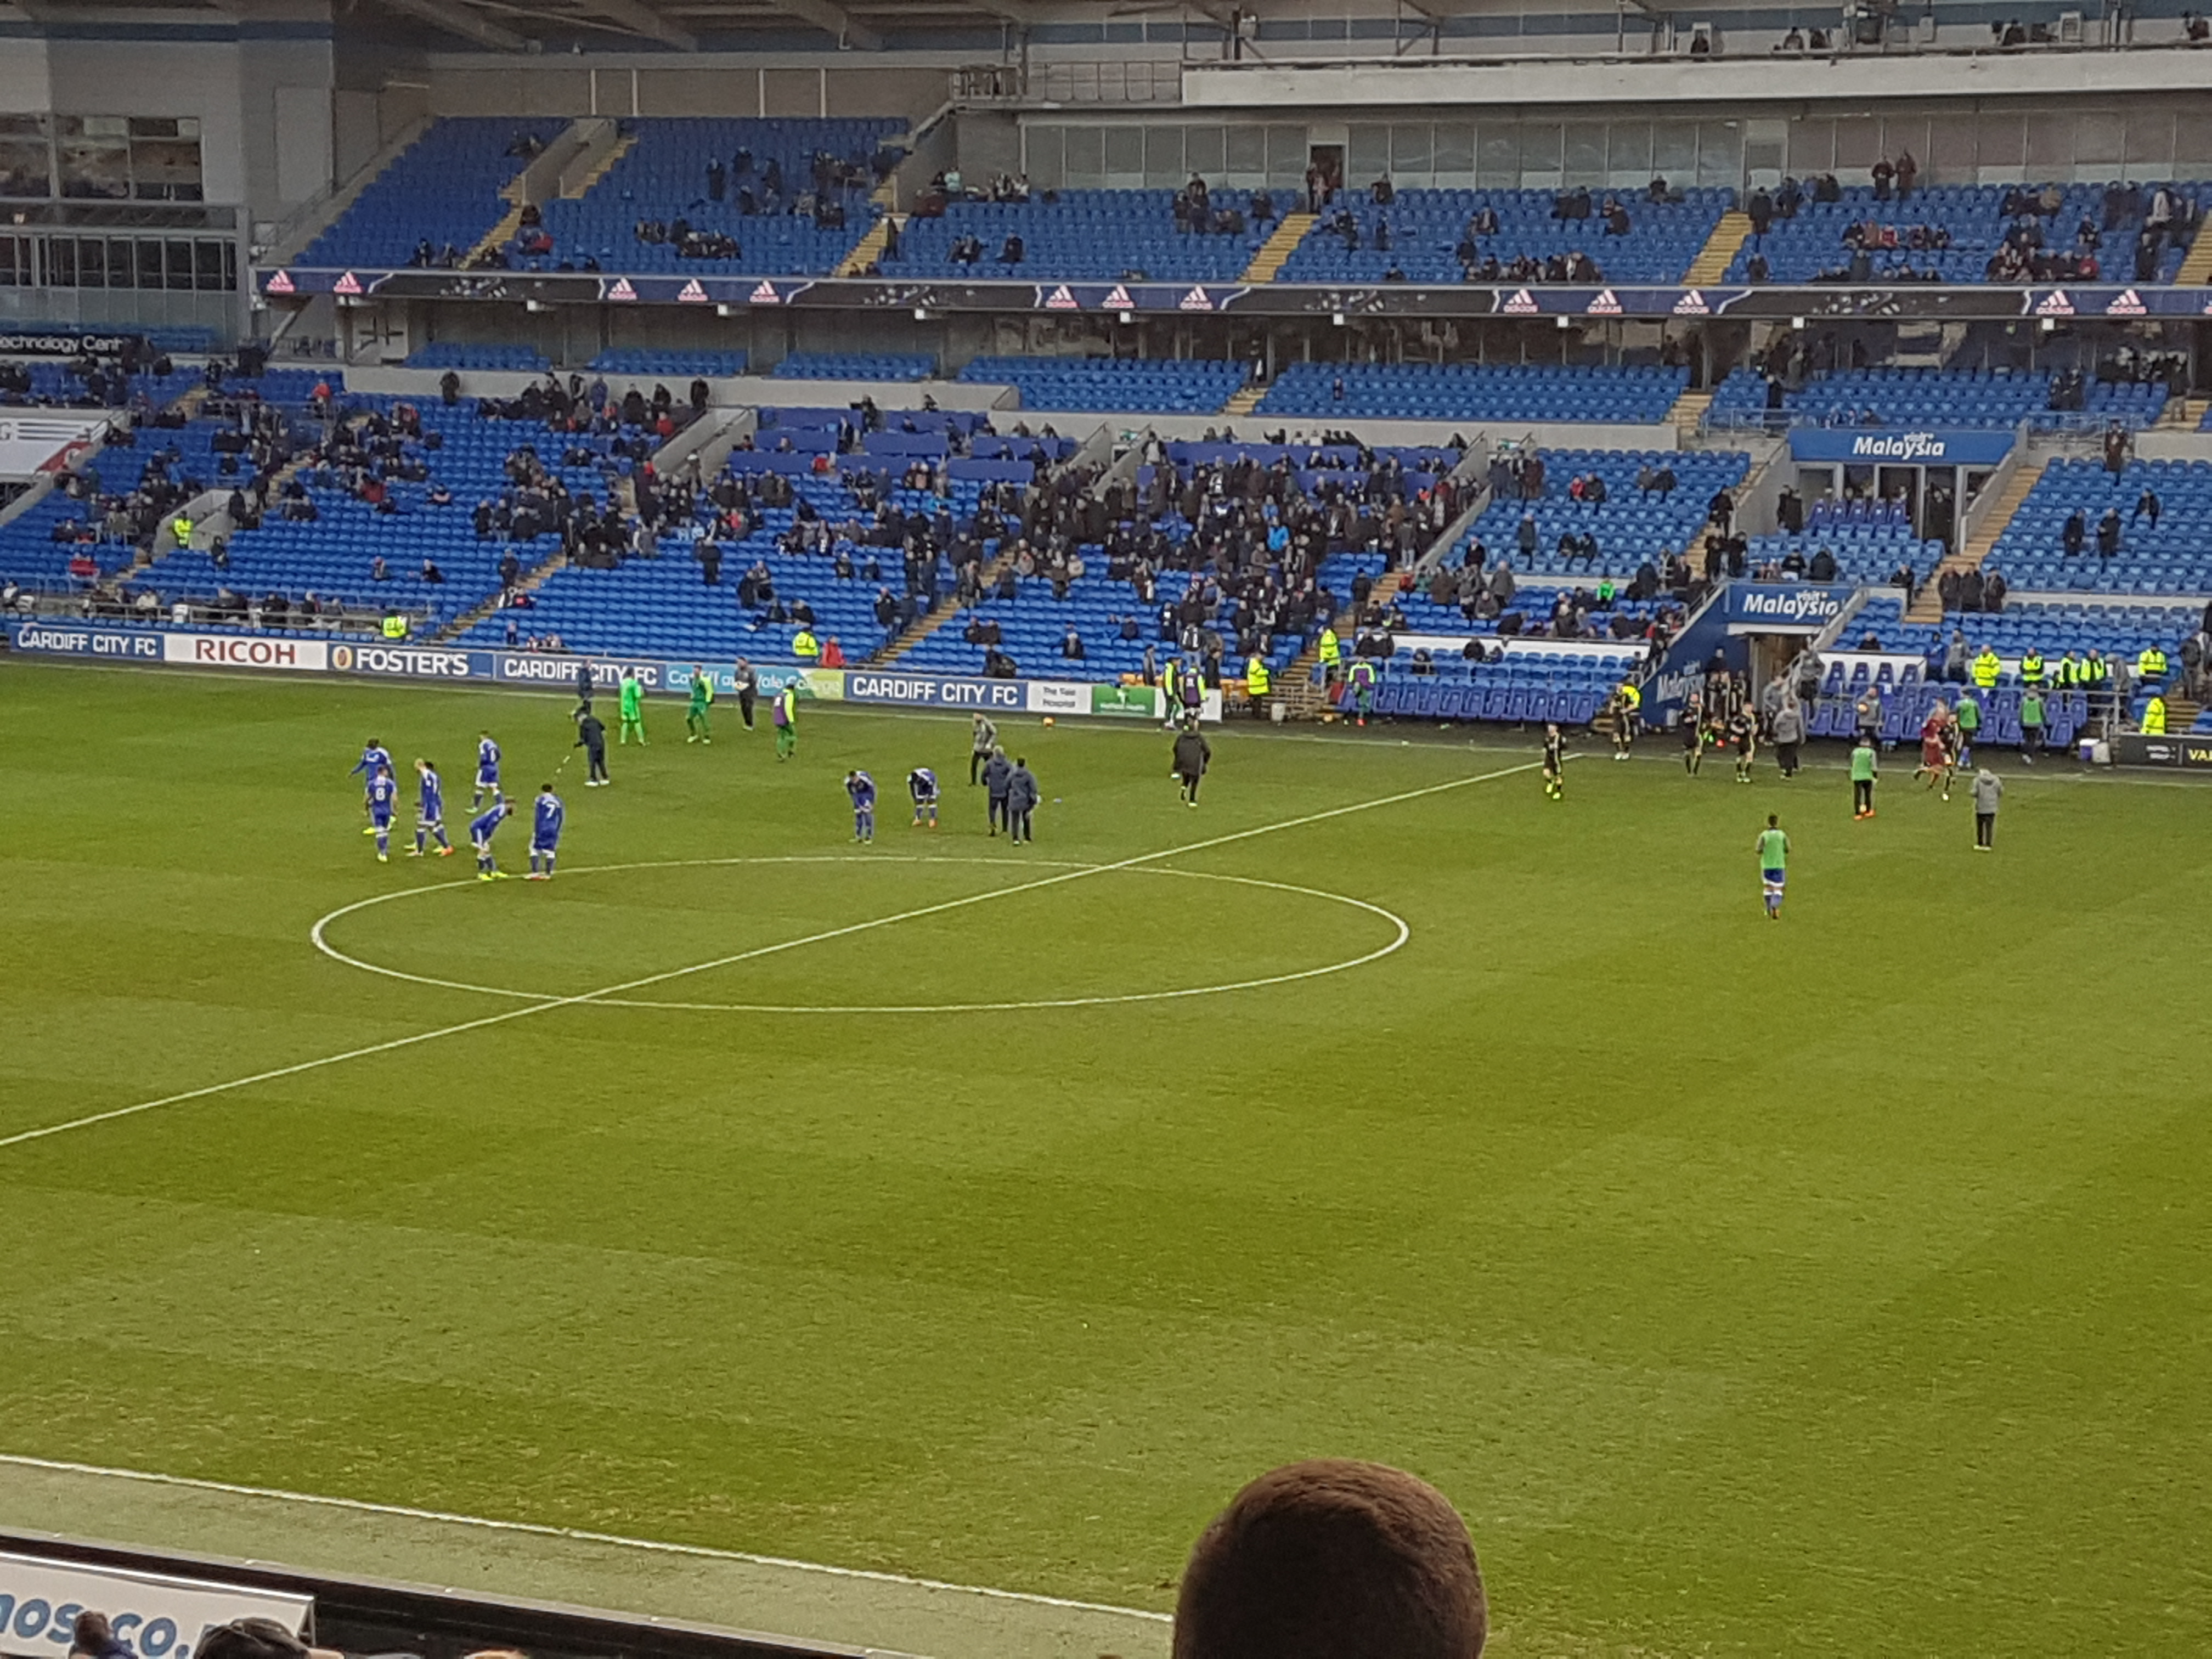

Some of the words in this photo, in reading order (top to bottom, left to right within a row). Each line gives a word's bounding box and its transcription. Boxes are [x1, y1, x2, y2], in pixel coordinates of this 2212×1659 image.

[82, 335, 123, 351] Cent
[1852, 436, 1945, 460] Malaysia
[18, 631, 88, 651] CARDIFF
[93, 634, 130, 654] CITY
[135, 637, 156, 656] FC
[195, 639, 295, 664] RICOH
[357, 648, 469, 676] FOSTER'S
[504, 659, 582, 680] CARDIFF
[589, 663, 628, 682] CITY
[634, 667, 657, 685] FC
[852, 676, 936, 702] CARDIFF
[941, 681, 987, 704] CITY
[992, 685, 1018, 706] FC
[546, 803, 556, 819] 7
